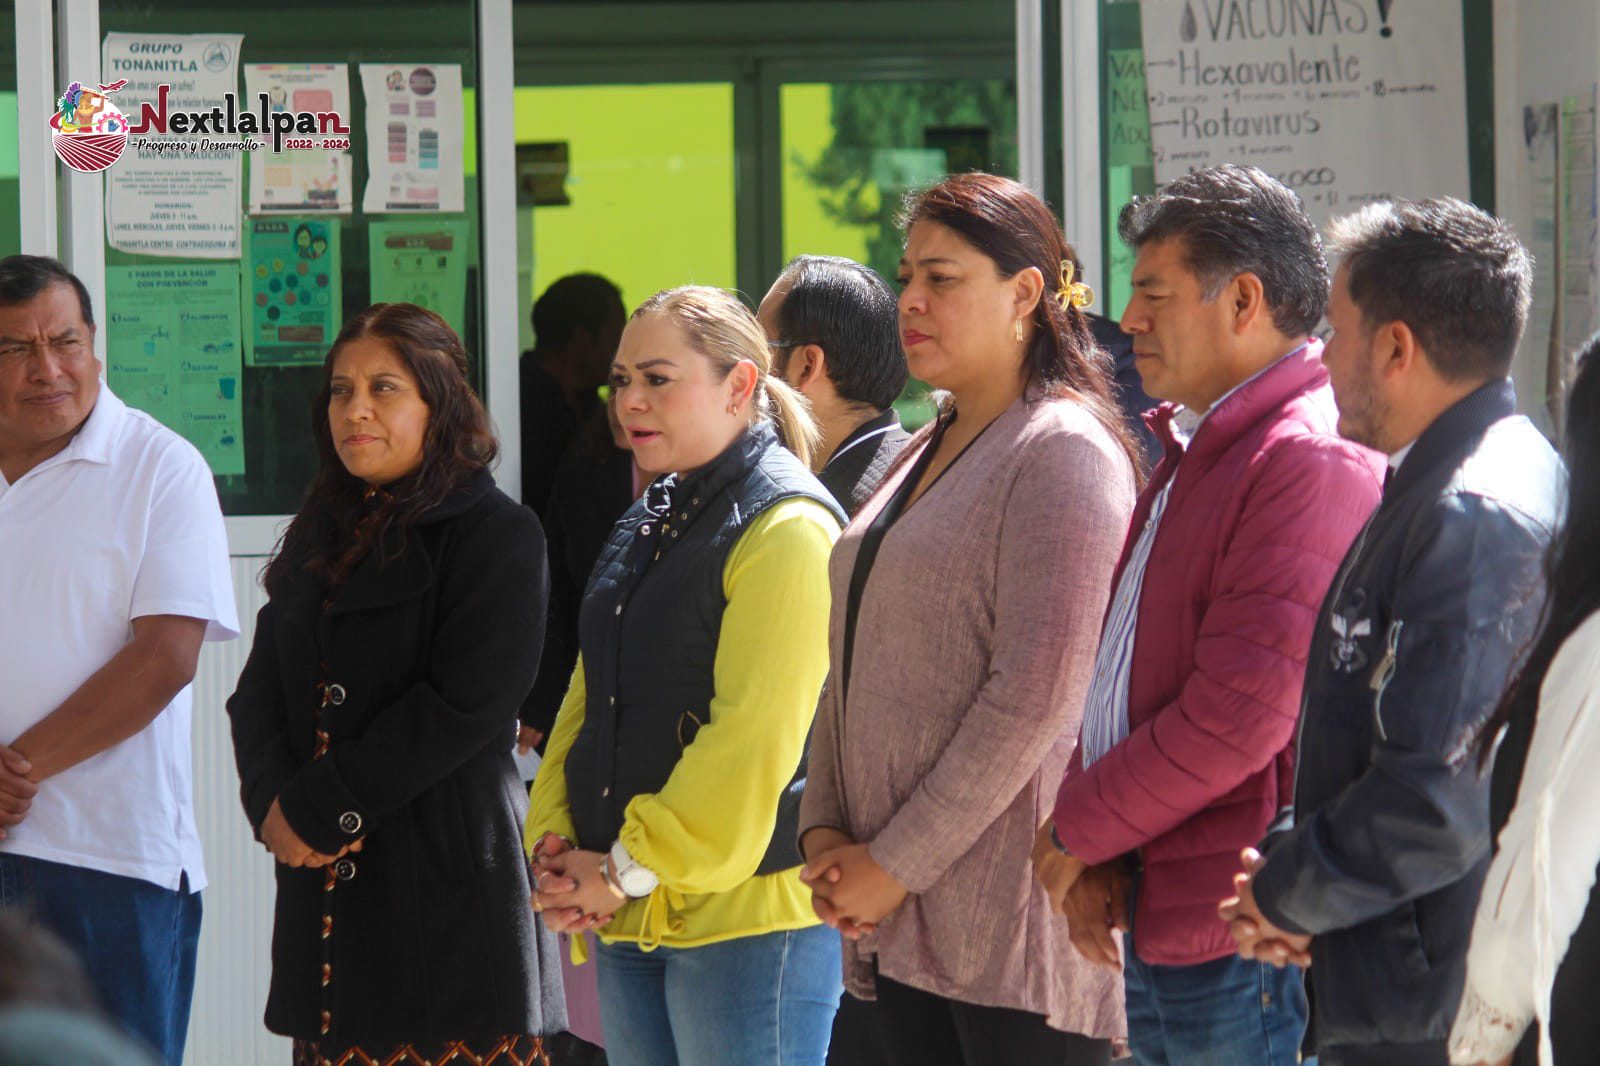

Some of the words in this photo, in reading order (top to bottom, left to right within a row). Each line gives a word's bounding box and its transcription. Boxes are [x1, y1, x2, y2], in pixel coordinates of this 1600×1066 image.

[129, 42, 183, 54] GRUPO
[111, 59, 199, 72] TONANITLA
[1178, 43, 1361, 86] Hexavalente
[1182, 105, 1320, 139] Rotavirus
[177, 270, 188, 278] LA
